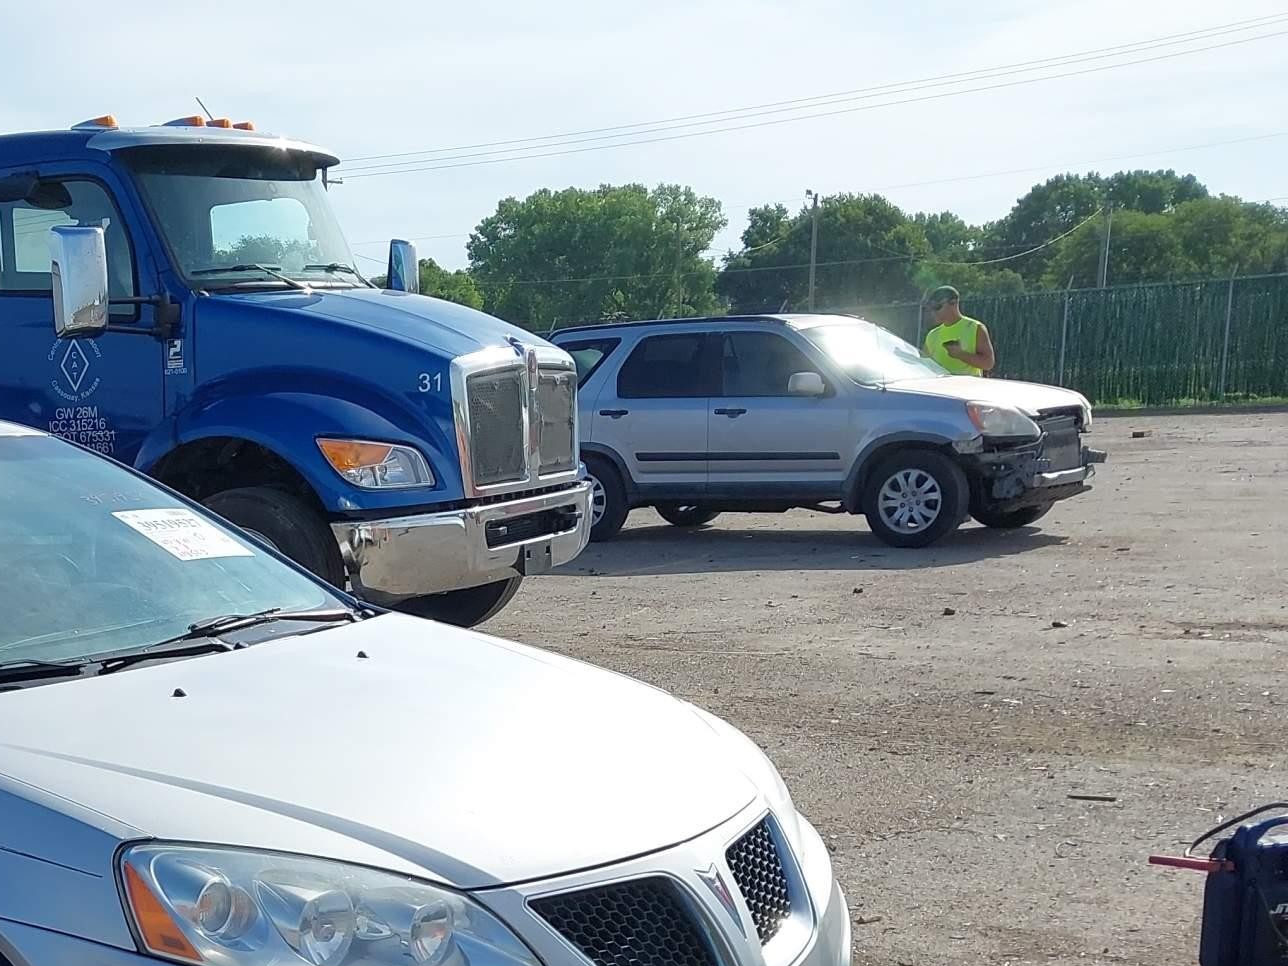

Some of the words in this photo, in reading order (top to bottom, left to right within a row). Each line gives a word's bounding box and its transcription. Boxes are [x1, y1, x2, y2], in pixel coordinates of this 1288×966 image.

[418, 372, 441, 392] 31
[55, 407, 73, 420] GW
[76, 406, 98, 418] 26M
[48, 420, 70, 432] ICC
[69, 418, 106, 431] 315216
